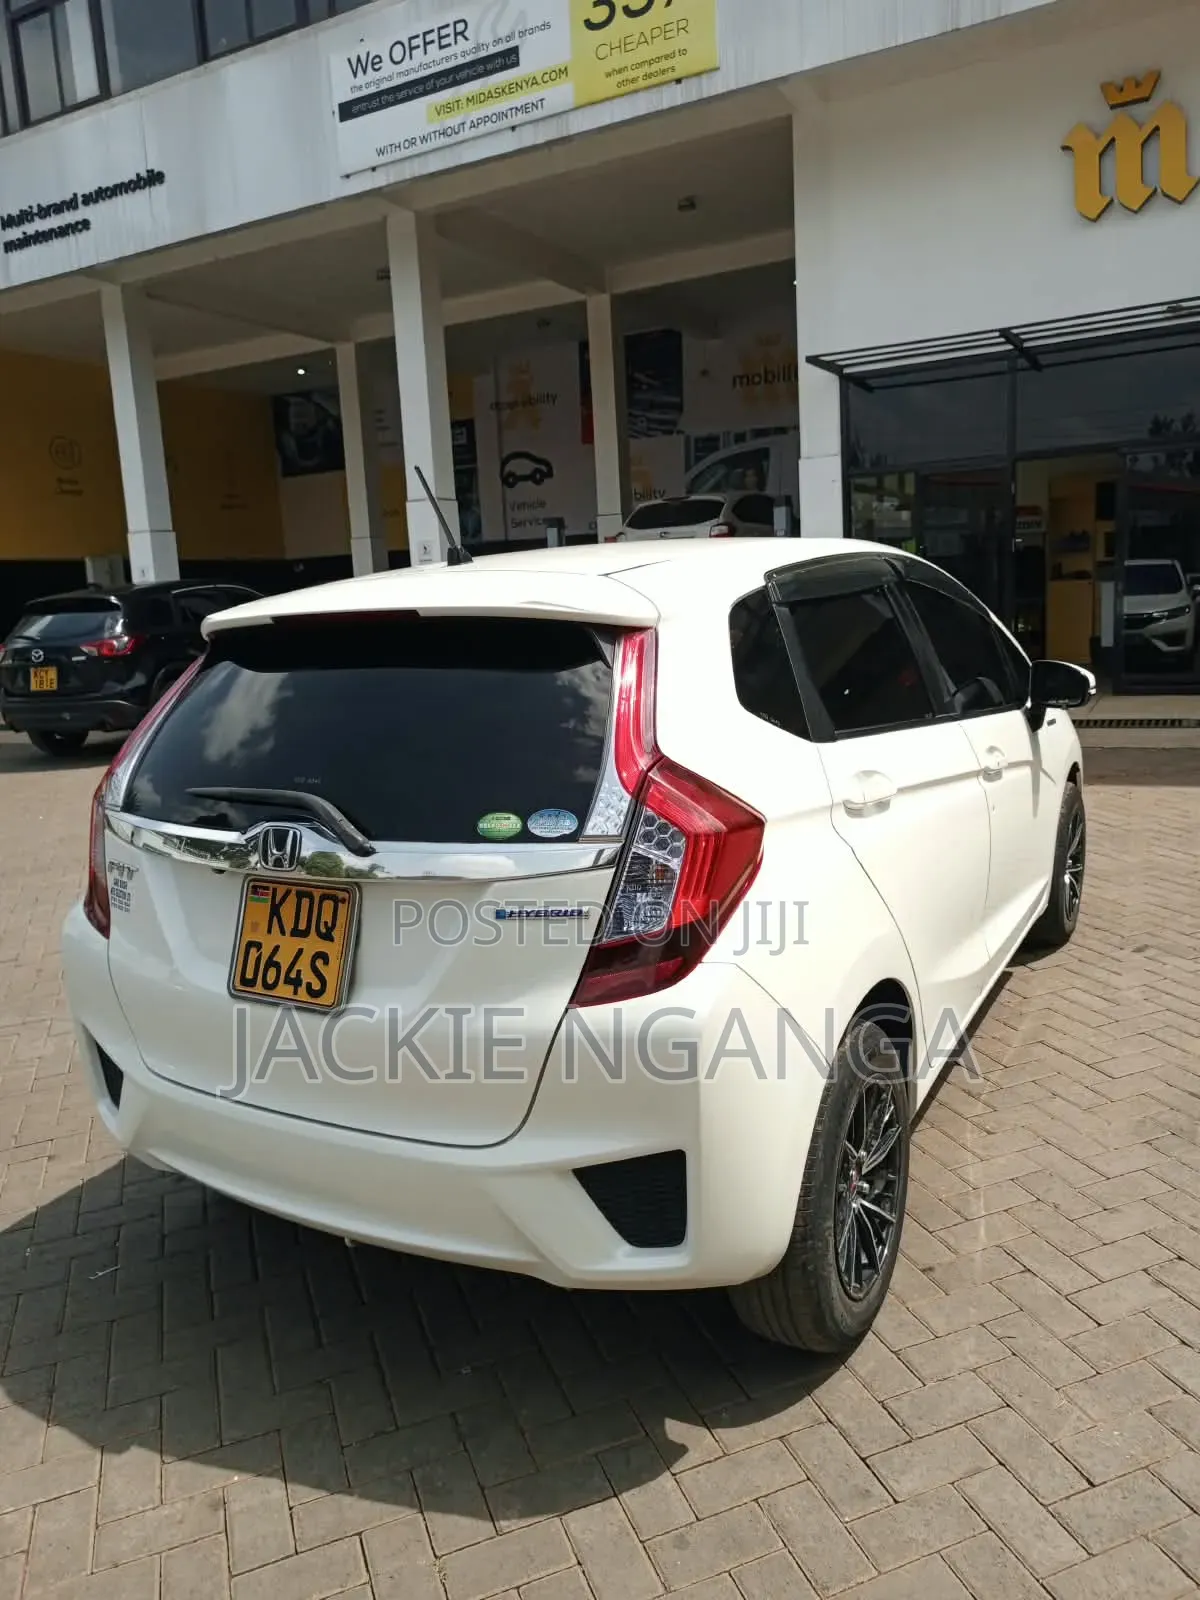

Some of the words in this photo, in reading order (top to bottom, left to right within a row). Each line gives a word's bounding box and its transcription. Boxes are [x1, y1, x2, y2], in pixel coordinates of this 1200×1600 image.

[347, 51, 383, 80] We
[389, 18, 470, 66] OFFER
[350, 83, 364, 94] the
[364, 72, 394, 91] original
[396, 51, 459, 78] manufacturers
[460, 40, 490, 60] quality
[492, 38, 504, 48] on
[505, 30, 517, 43] all
[518, 20, 552, 38] brands
[595, 18, 690, 61] CHEAPER
[604, 66, 629, 79] when
[630, 50, 677, 72] compared
[678, 47, 688, 57] to
[434, 98, 465, 117] VISIT:
[466, 66, 569, 107] MIDASKENYA.COM
[616, 74, 641, 89] other
[642, 65, 677, 81] dealers
[375, 142, 401, 157] WITH
[402, 136, 418, 151] OR
[419, 122, 467, 145] WITHOUT
[469, 98, 546, 131] APPOINTMENT
[0, 191, 79, 231] Multi-brand
[80, 168, 166, 207] automobile
[3, 217, 92, 254] maintenance
[266, 887, 340, 942] KDQ
[239, 940, 330, 999] 064S
